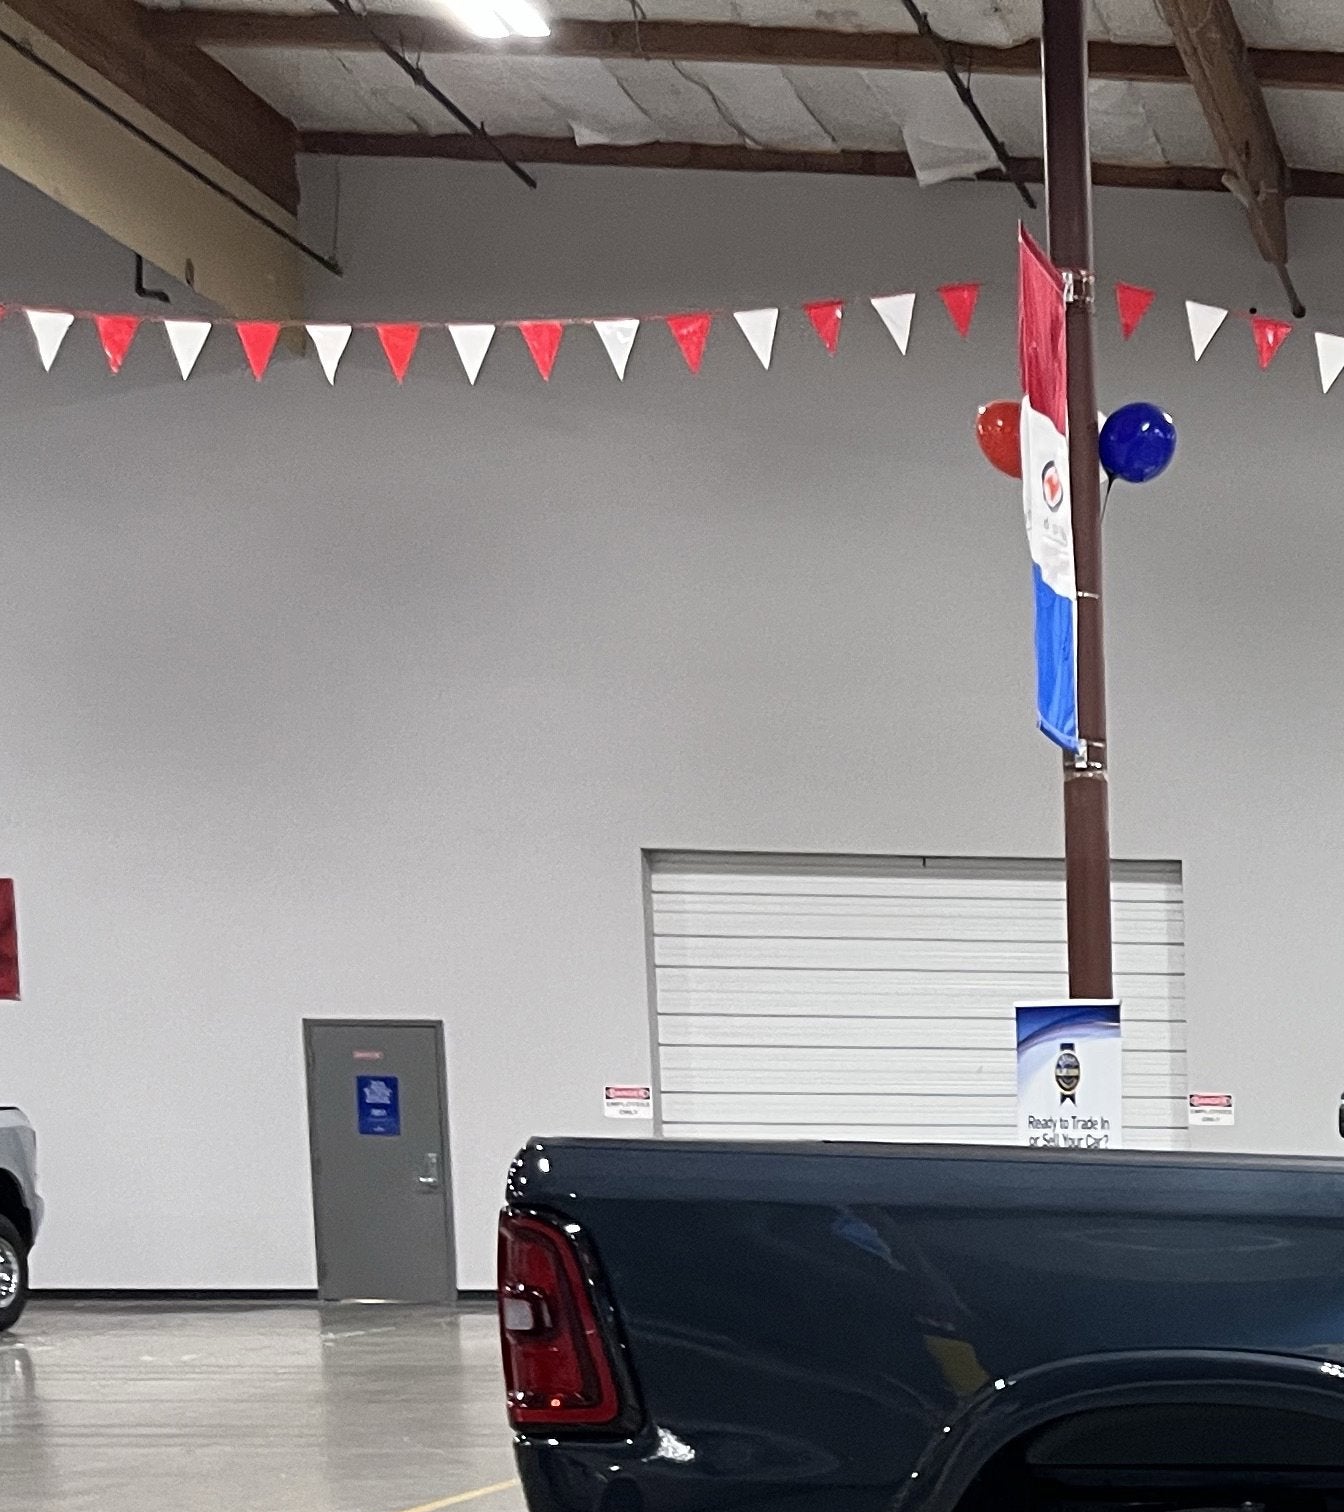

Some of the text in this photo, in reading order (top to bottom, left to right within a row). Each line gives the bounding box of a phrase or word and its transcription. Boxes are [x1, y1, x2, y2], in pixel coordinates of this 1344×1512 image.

[1028, 1115, 1110, 1132] Ready to Trade In
[1029, 1136, 1040, 1147] or
[1042, 1133, 1059, 1147] Sell
[1062, 1134, 1083, 1148] Your
